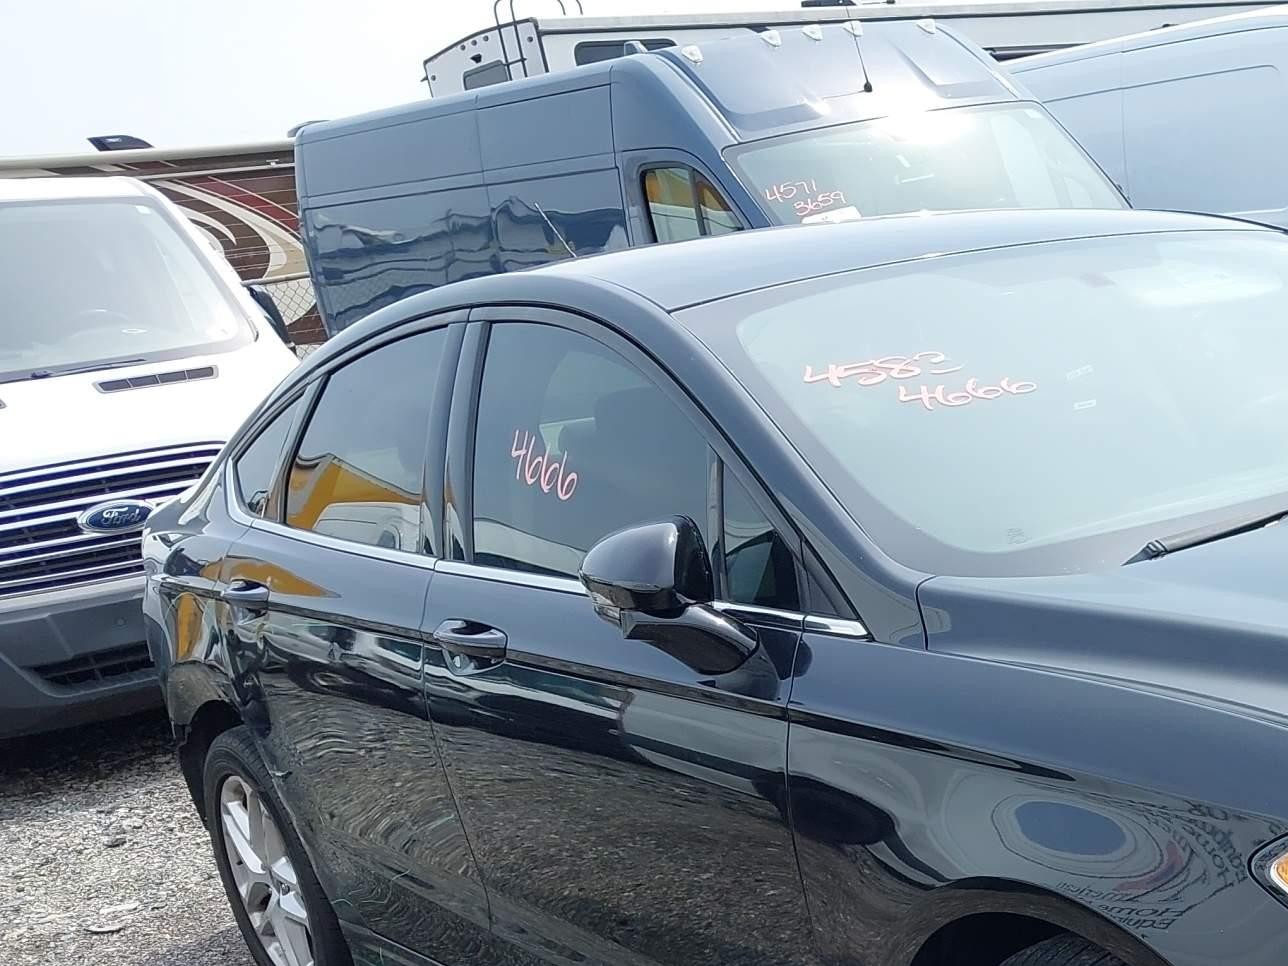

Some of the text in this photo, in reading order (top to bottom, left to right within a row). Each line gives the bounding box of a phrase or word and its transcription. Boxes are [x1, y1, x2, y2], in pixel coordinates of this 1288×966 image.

[765, 179, 817, 202] 4571
[793, 191, 847, 215] 3659
[899, 377, 1037, 410] 4666
[511, 429, 578, 501] 4666
[101, 506, 142, 526] Ford
